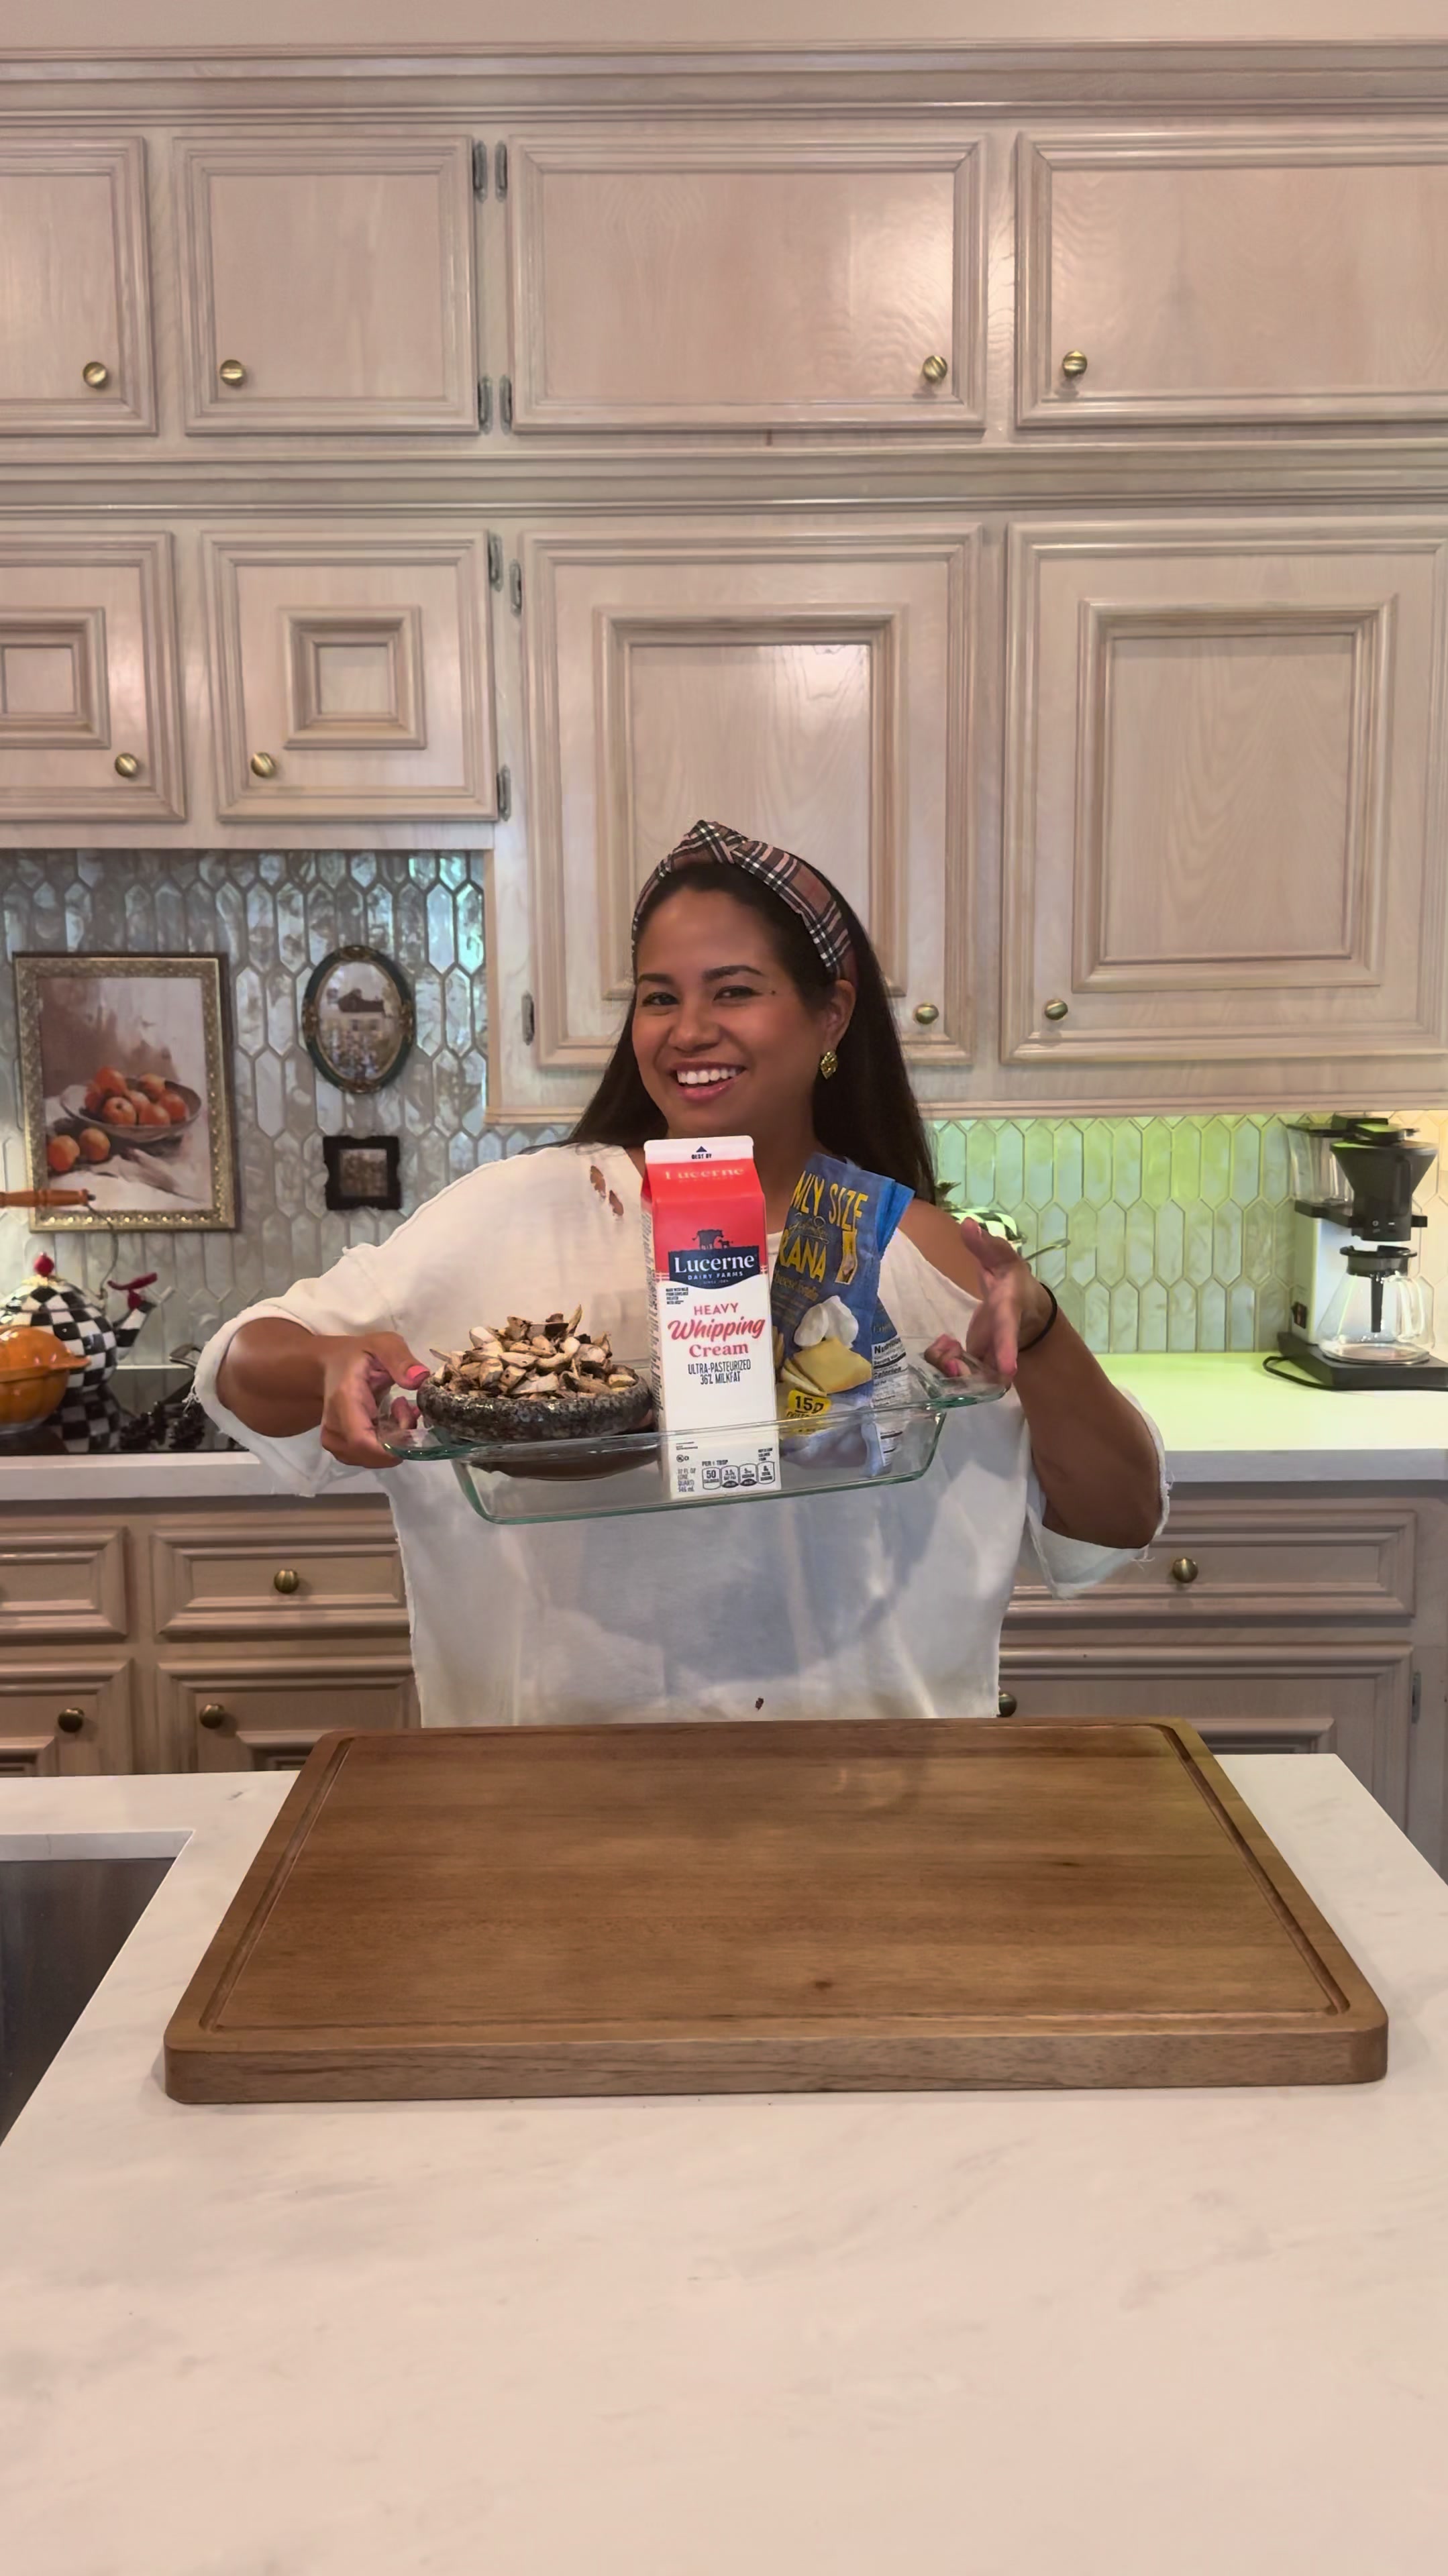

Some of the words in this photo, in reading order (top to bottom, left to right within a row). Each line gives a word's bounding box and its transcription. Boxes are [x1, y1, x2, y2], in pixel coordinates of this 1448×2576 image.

[828, 1183, 869, 1231] SIZE
[674, 1255, 754, 1273] Lucerne
[694, 1303, 739, 1316] HEAVY
[667, 1316, 766, 1342] Whipping
[689, 1343, 749, 1358] Cream
[688, 1359, 751, 1375] ULTRA-PASTEURIZED
[715, 1371, 741, 1384] MILKFAT
[706, 1470, 716, 1479] 50
